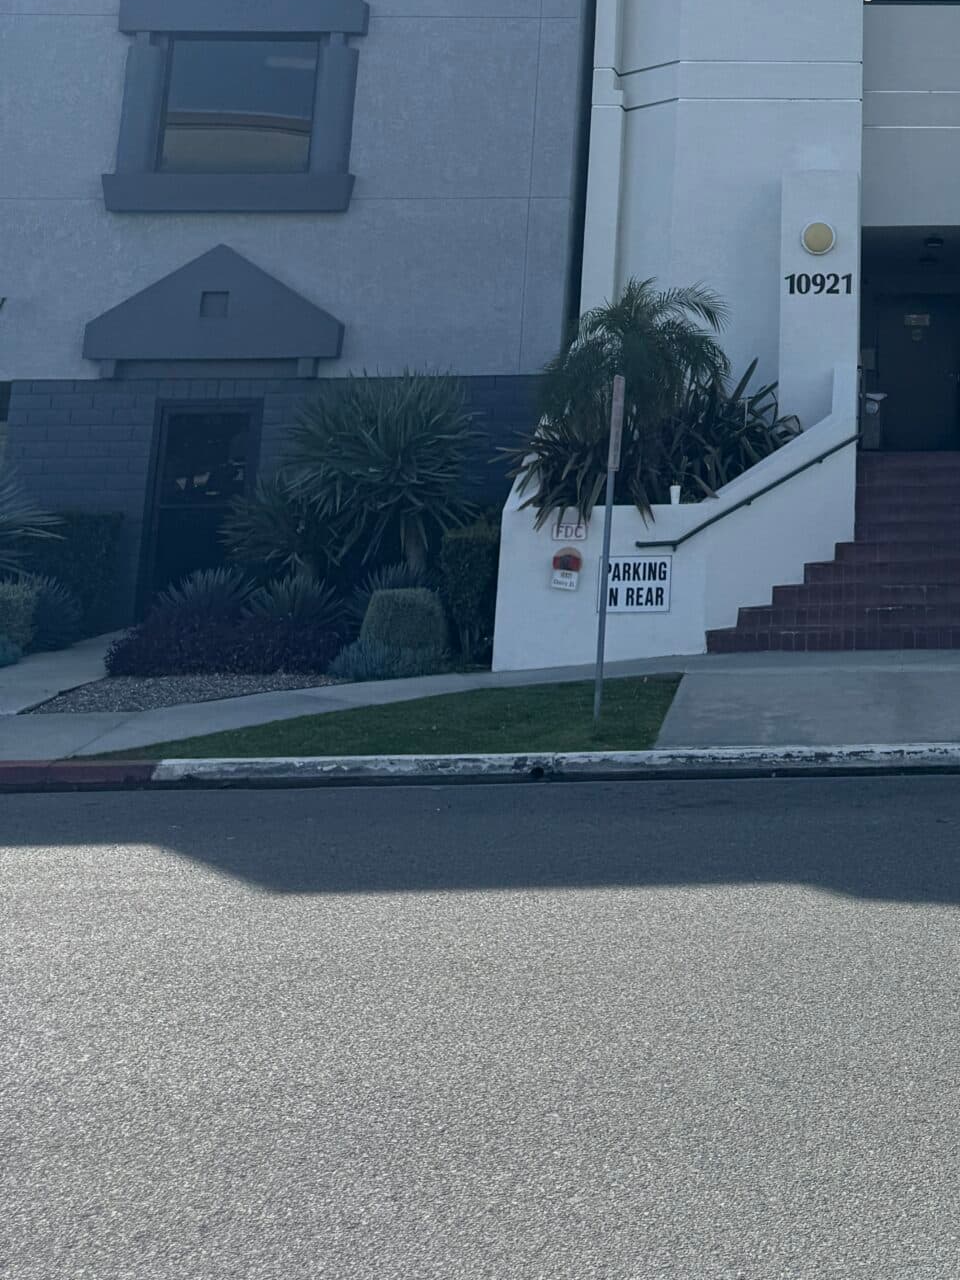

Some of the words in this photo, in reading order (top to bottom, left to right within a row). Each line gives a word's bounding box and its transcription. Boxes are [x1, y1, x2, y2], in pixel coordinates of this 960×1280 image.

[784, 272, 854, 295] 10921
[556, 525, 583, 538] FDC
[626, 587, 665, 607] REAR
